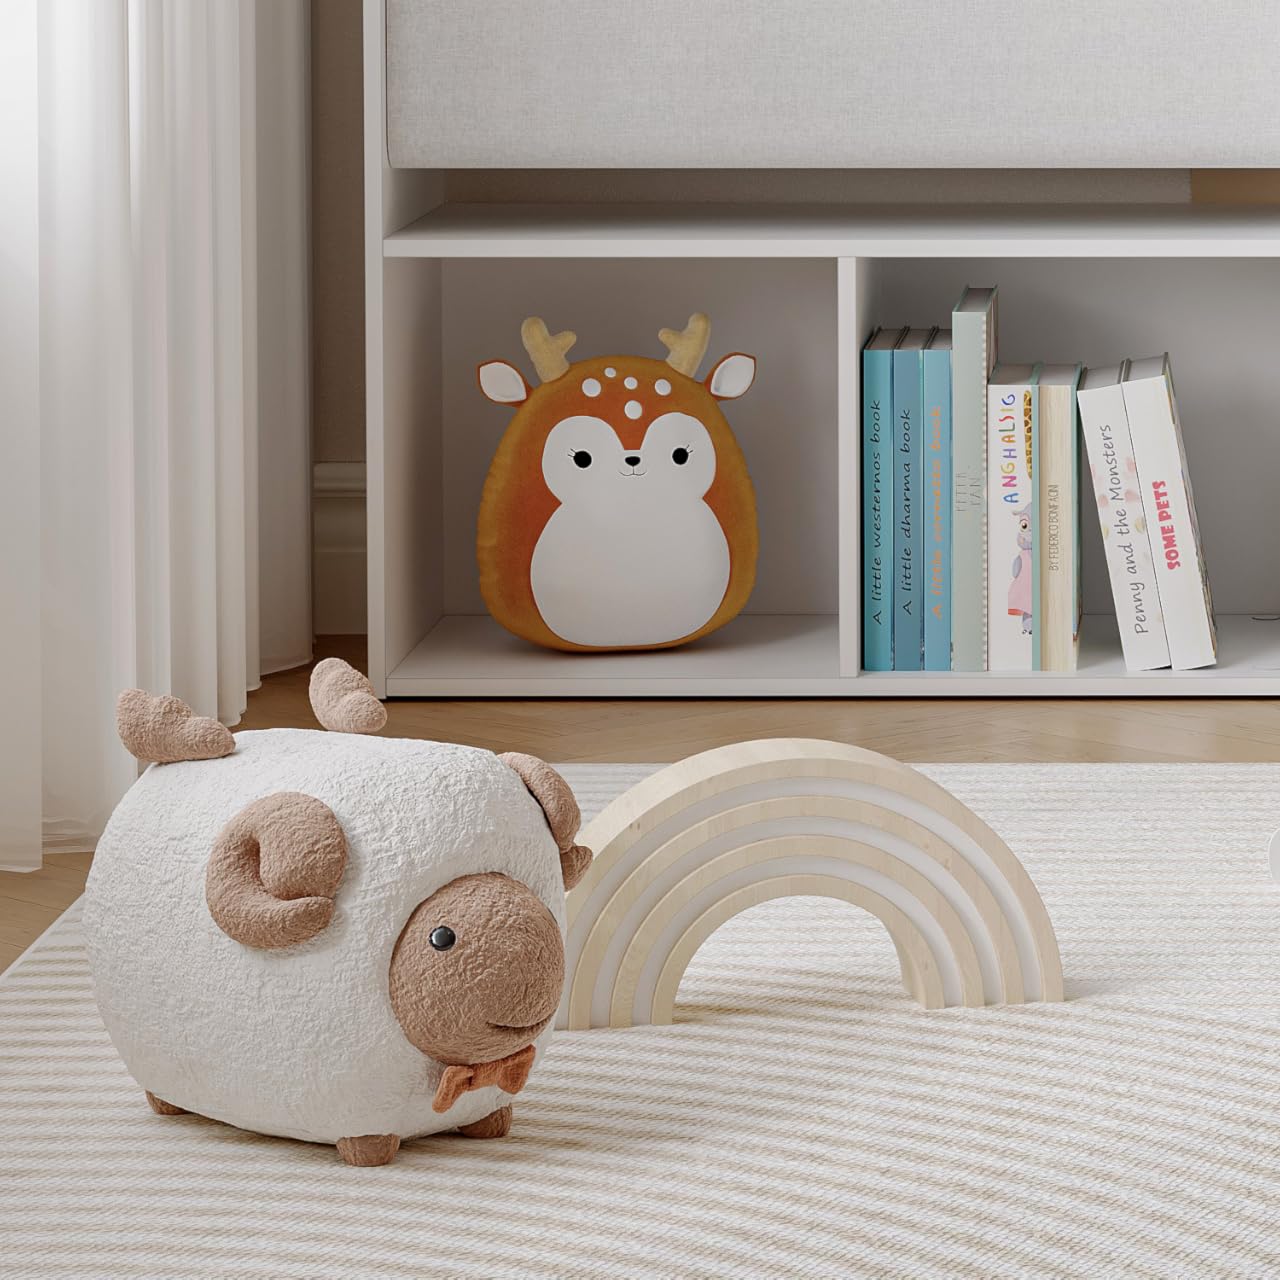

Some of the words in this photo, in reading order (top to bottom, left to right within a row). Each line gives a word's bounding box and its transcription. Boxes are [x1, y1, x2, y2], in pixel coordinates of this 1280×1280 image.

[870, 399, 881, 444] book
[900, 408, 911, 453] book
[1100, 424, 1125, 501] Monsters
[872, 452, 882, 548] westernos
[900, 462, 912, 537] dharma
[1152, 480, 1171, 521] PETS
[1114, 509, 1128, 536] the
[901, 547, 912, 593] little
[1119, 542, 1137, 575] and
[1161, 525, 1181, 570] SOME
[872, 555, 882, 601] little
[872, 610, 882, 625] A
[902, 600, 912, 615] A
[1132, 582, 1148, 634] Penny
